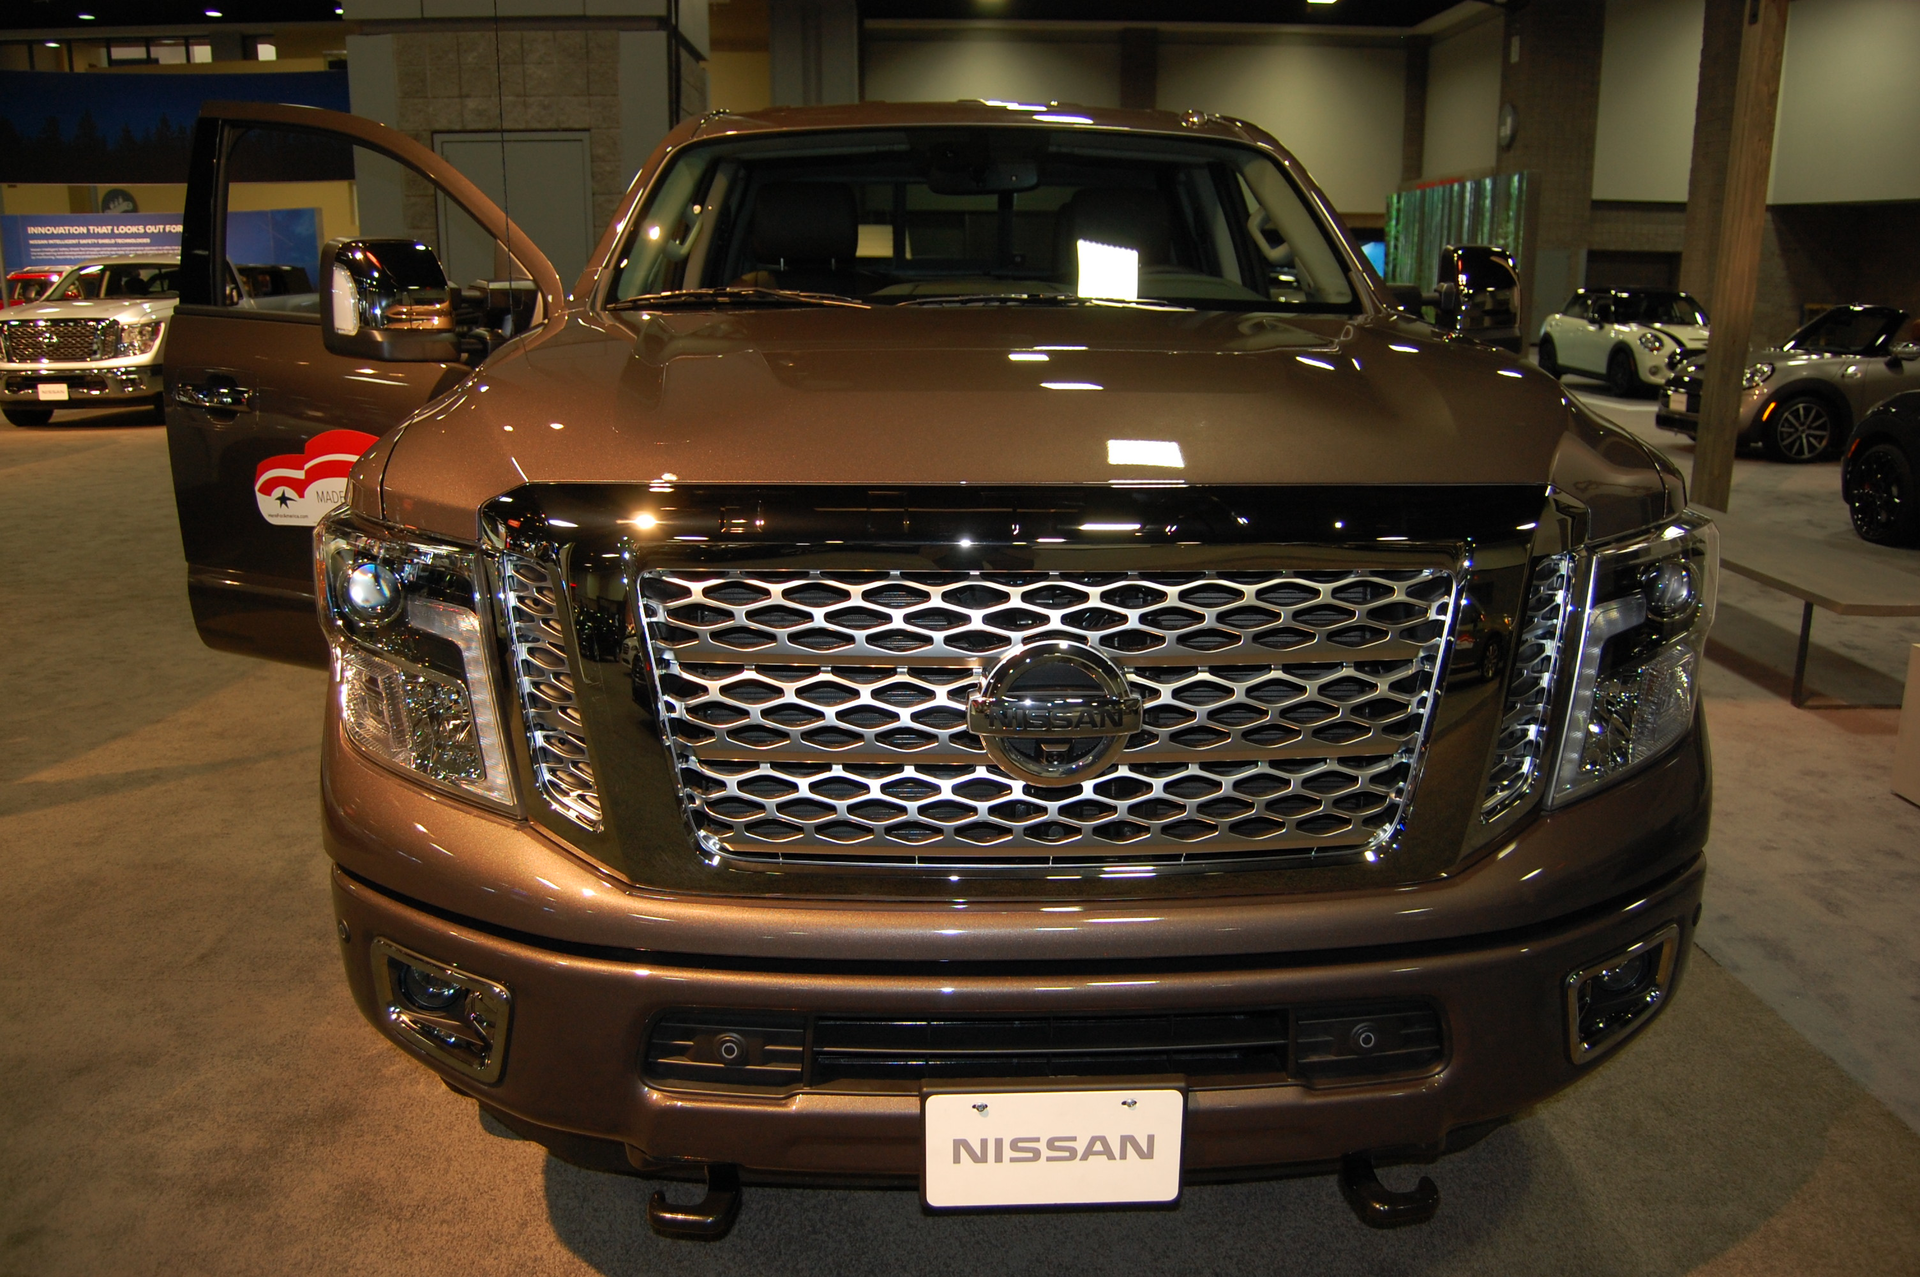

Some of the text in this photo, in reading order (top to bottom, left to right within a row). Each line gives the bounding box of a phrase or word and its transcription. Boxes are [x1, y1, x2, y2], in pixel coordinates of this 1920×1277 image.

[27, 224, 183, 234] INNOVATION THAT LOOKS OUT FOR
[316, 490, 345, 503] MADE
[988, 707, 1124, 731] NISSAN
[952, 1134, 1155, 1164] NISSAN
